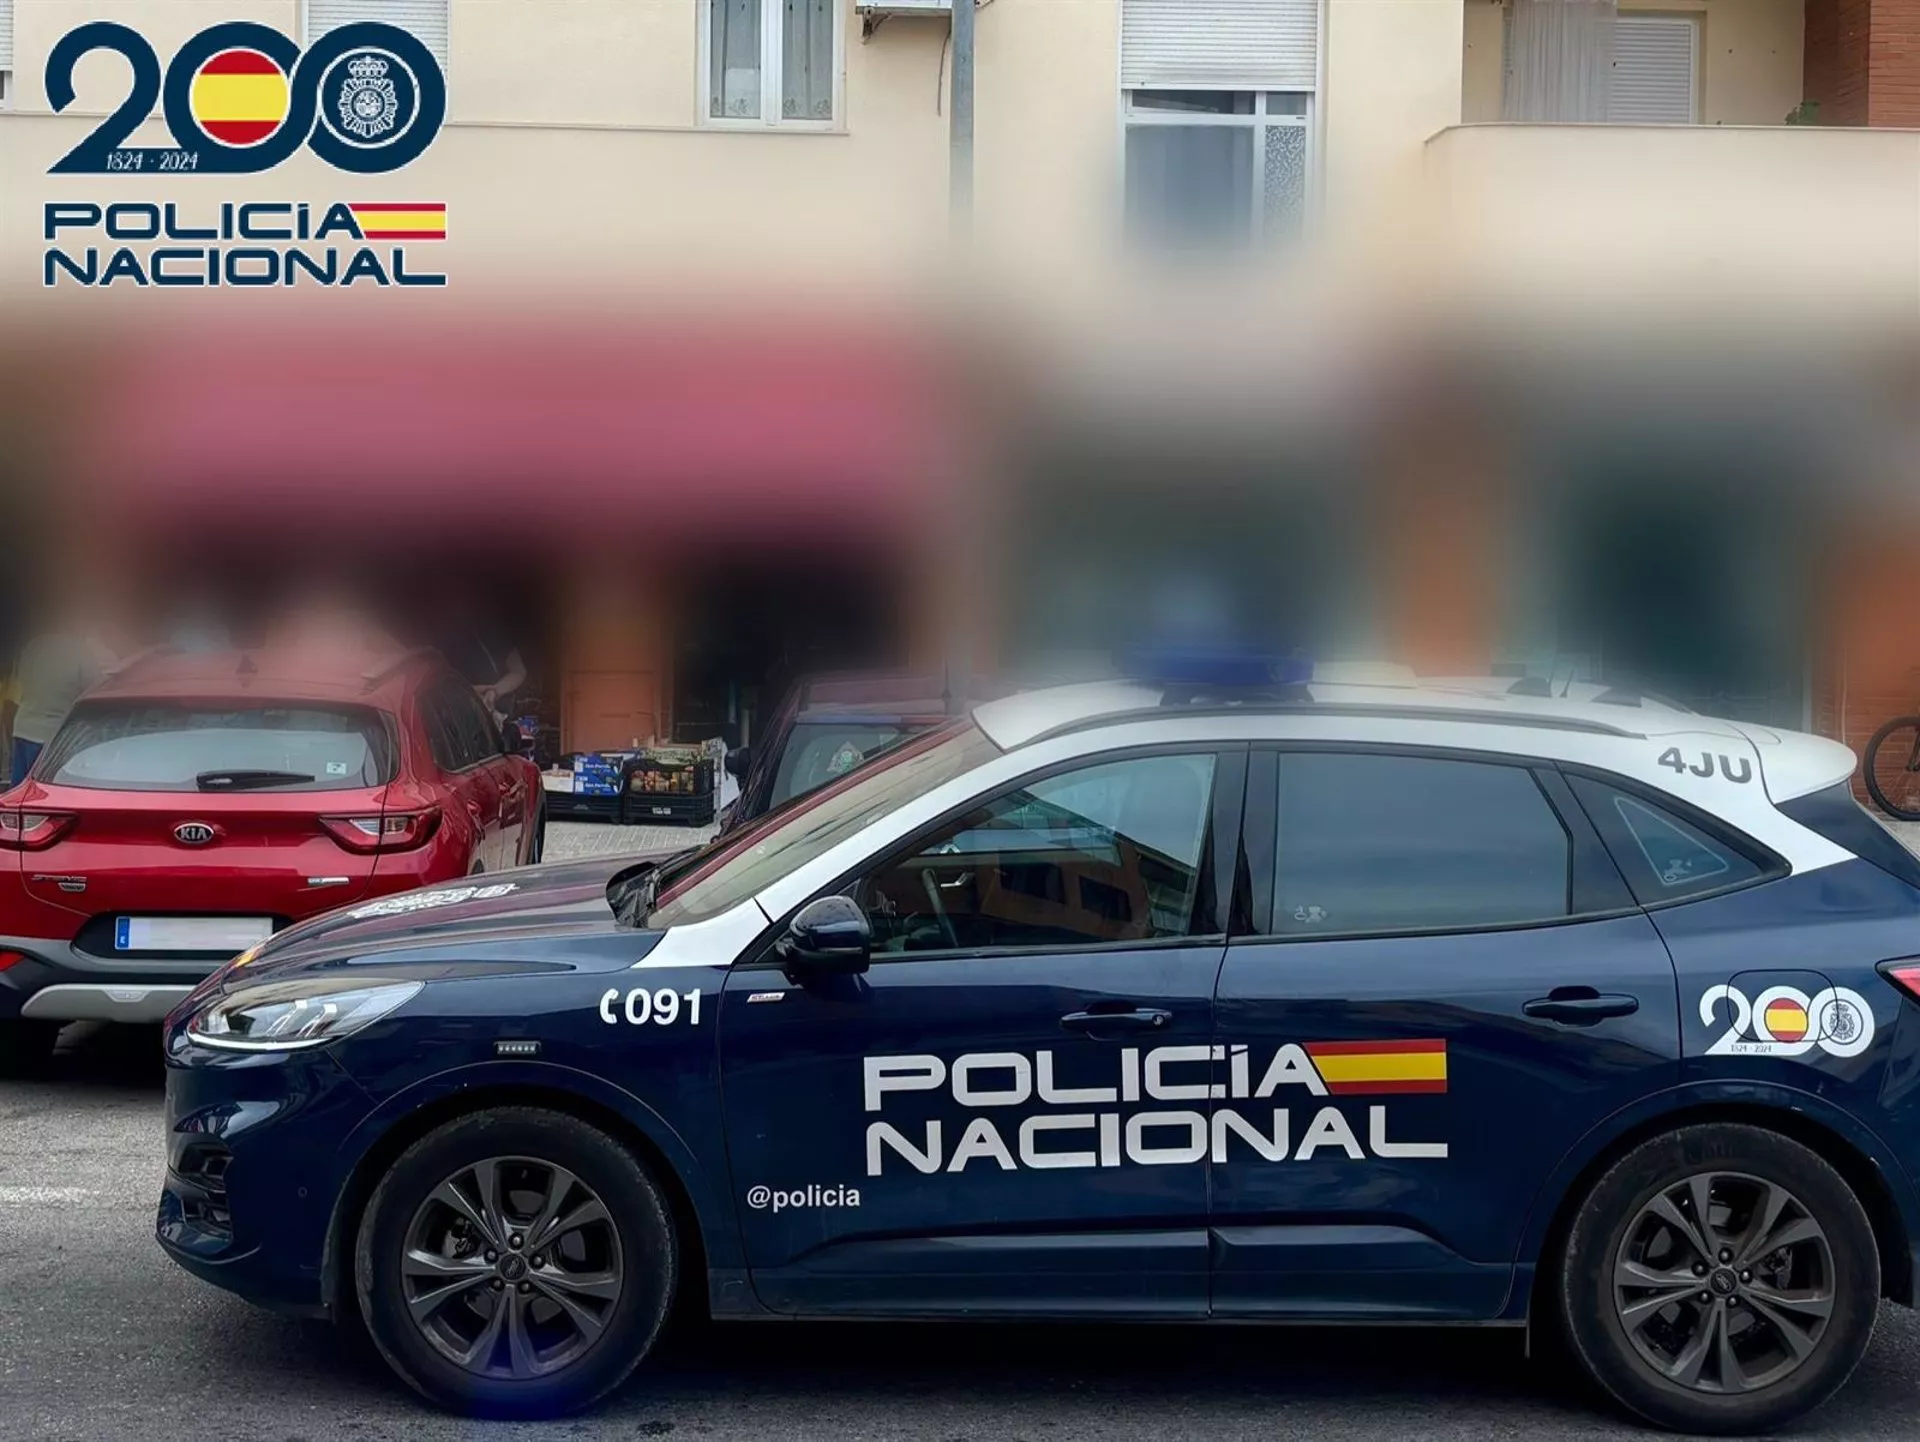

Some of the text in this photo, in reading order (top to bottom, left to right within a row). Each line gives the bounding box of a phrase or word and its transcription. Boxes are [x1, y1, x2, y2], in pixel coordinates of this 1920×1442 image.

[1657, 747, 1752, 784] 4JU
[180, 827, 208, 840] KIA
[625, 988, 701, 1025] 091
[1699, 984, 1875, 1058] 200
[866, 1104, 1449, 1176] NACIONAL
[747, 1184, 861, 1213] @policia
